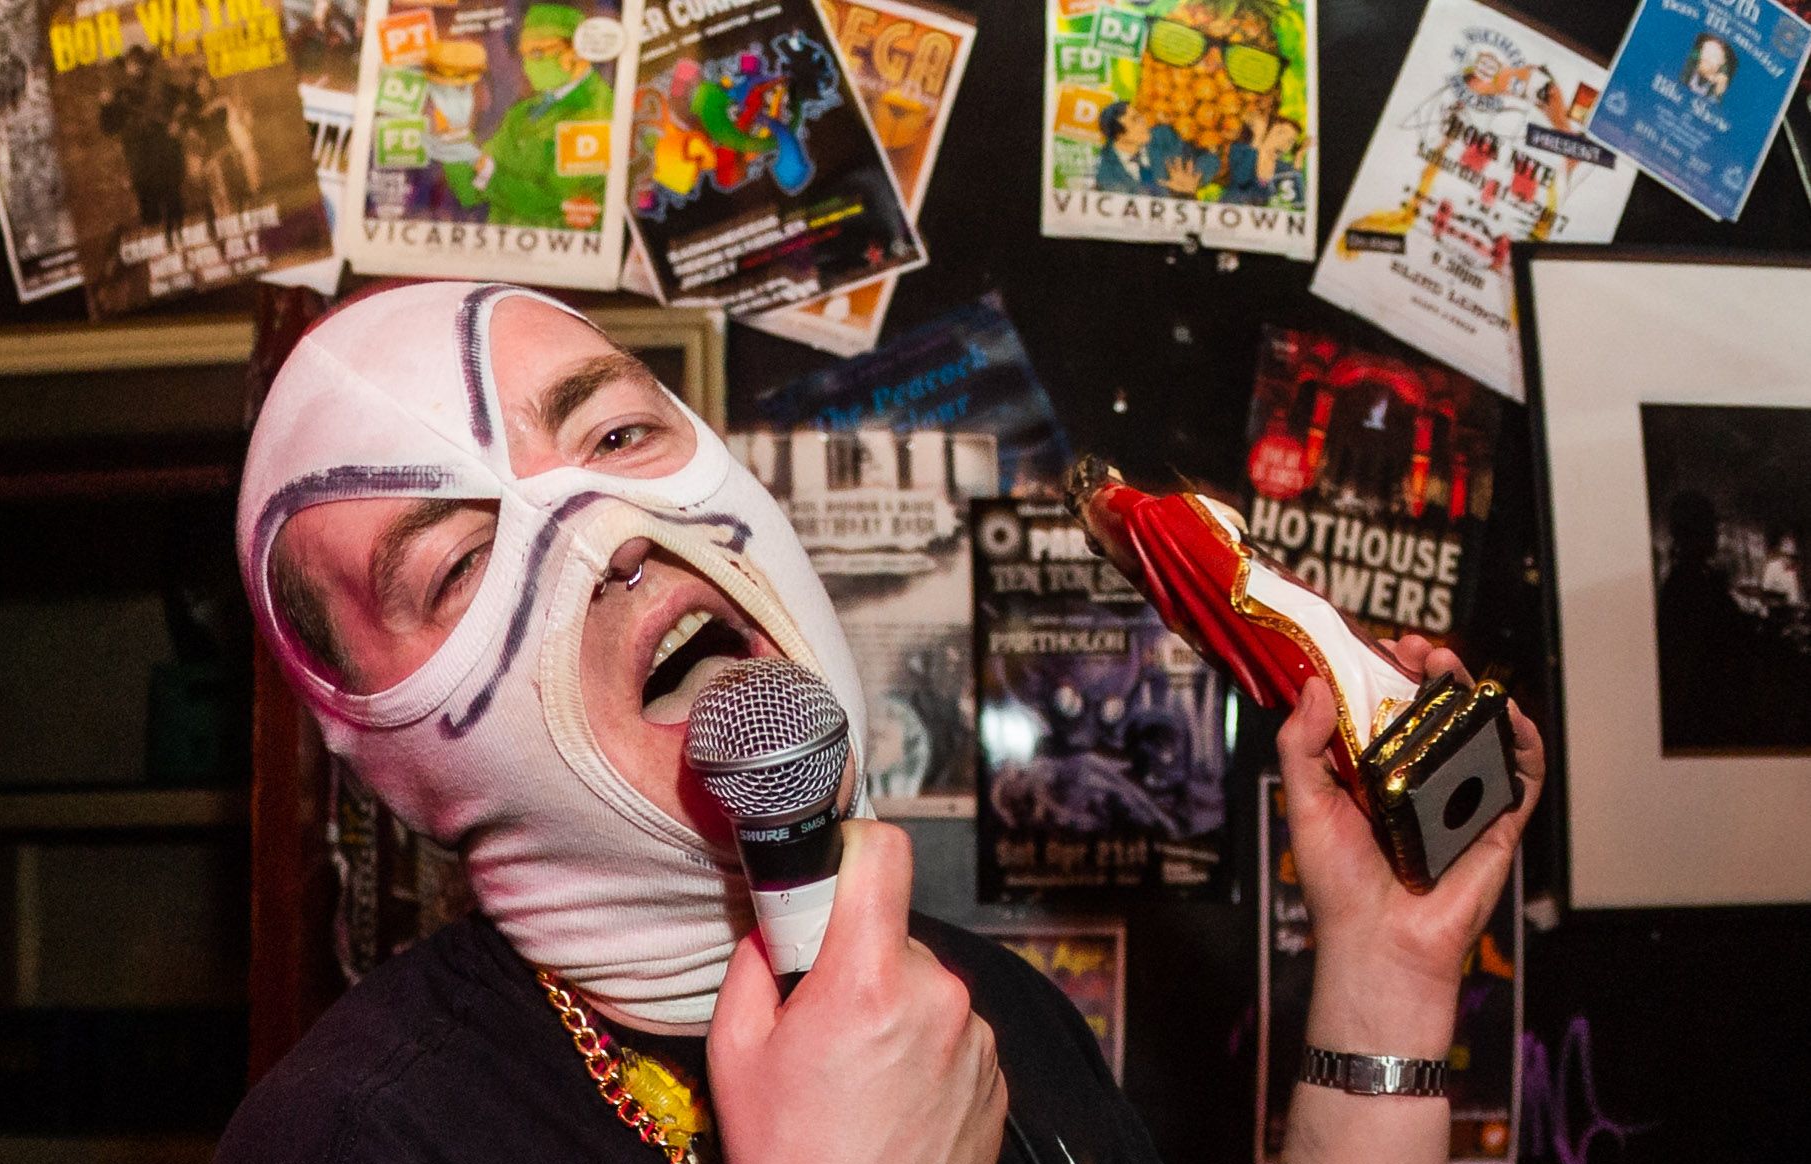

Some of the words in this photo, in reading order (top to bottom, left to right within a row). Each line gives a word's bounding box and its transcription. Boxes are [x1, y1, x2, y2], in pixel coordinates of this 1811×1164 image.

[385, 22, 427, 50] PT
[1099, 17, 1141, 43] DJ
[1062, 47, 1103, 72] FD
[1073, 99, 1098, 122] D
[575, 135, 599, 158] D
[1053, 190, 1306, 236] VICARSTOWN
[363, 219, 601, 255] VICARSTOWN
[1250, 495, 1463, 586] HOTHOUSE
[739, 827, 790, 842] SHURE
